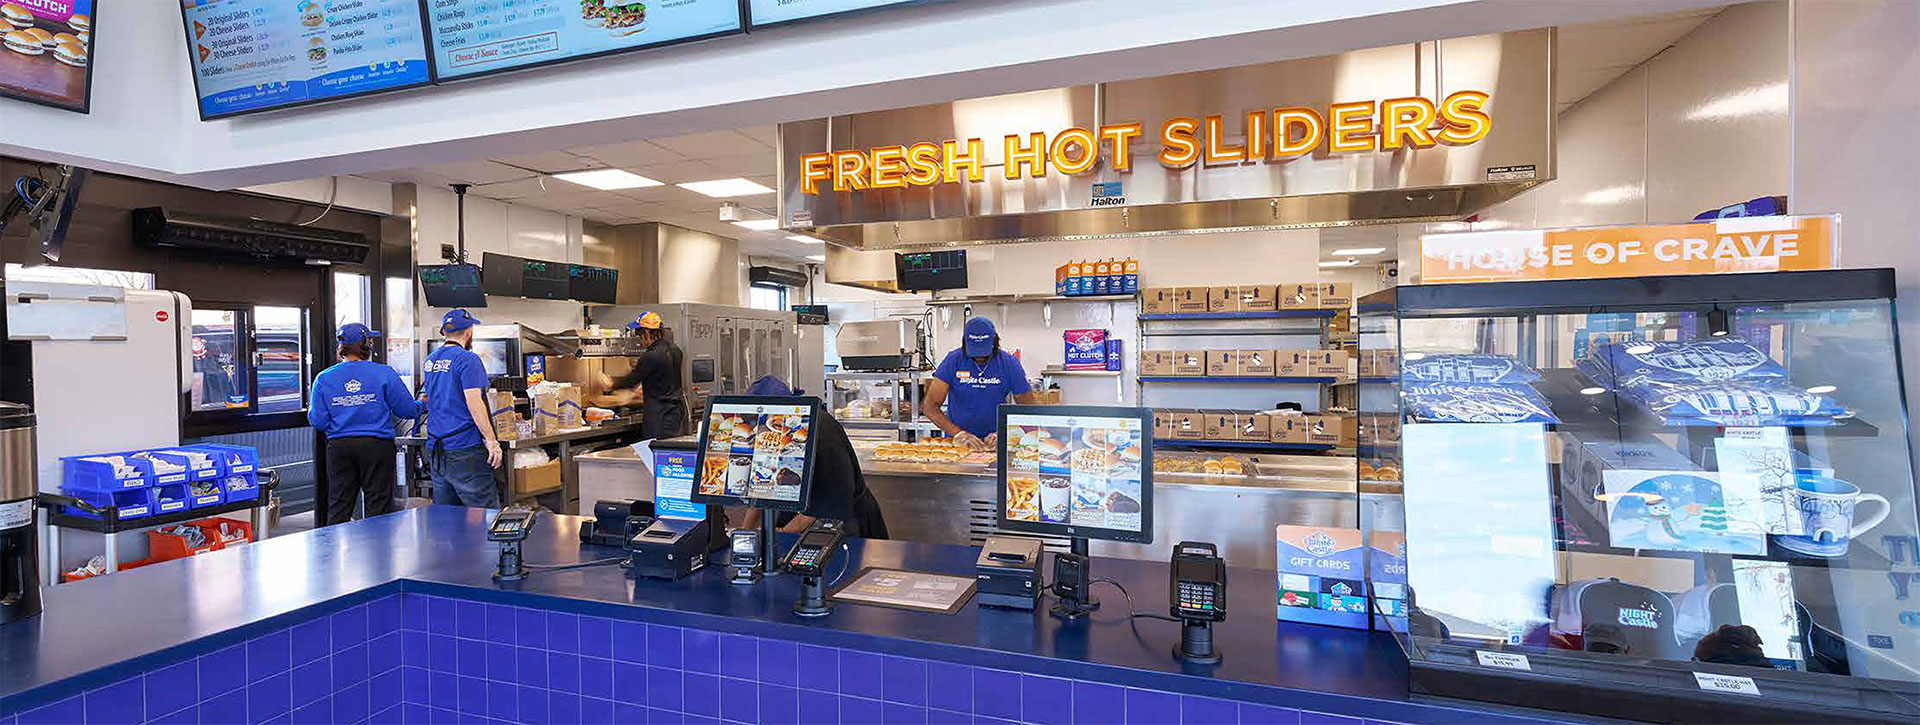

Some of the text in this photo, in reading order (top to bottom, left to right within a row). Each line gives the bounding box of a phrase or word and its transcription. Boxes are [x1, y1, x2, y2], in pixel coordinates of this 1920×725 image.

[19, 0, 67, 13] LUTCH
[338, 3, 352, 11] Chicken
[214, 12, 233, 25] Original
[233, 10, 249, 20] Sliders
[437, 12, 453, 21] Chicken
[216, 25, 233, 35] Cheese
[233, 21, 249, 31] Sliders
[218, 37, 237, 48] Original
[237, 34, 253, 43] Sliders
[440, 39, 455, 47] Cheese
[220, 48, 237, 58] Cheese
[237, 46, 253, 55] Sliders
[210, 66, 225, 76] Sliders
[800, 90, 1493, 196] FRESH HOT SLIDERS
[1091, 197, 1126, 206] Halton
[1447, 233, 1798, 272] HOUSE OF CRAVE
[1290, 556, 1351, 570] GIFT CARDS
[1618, 607, 1656, 621] NIGHT
[1618, 616, 1658, 629] Castle
[1714, 682, 1741, 690] $25.00
